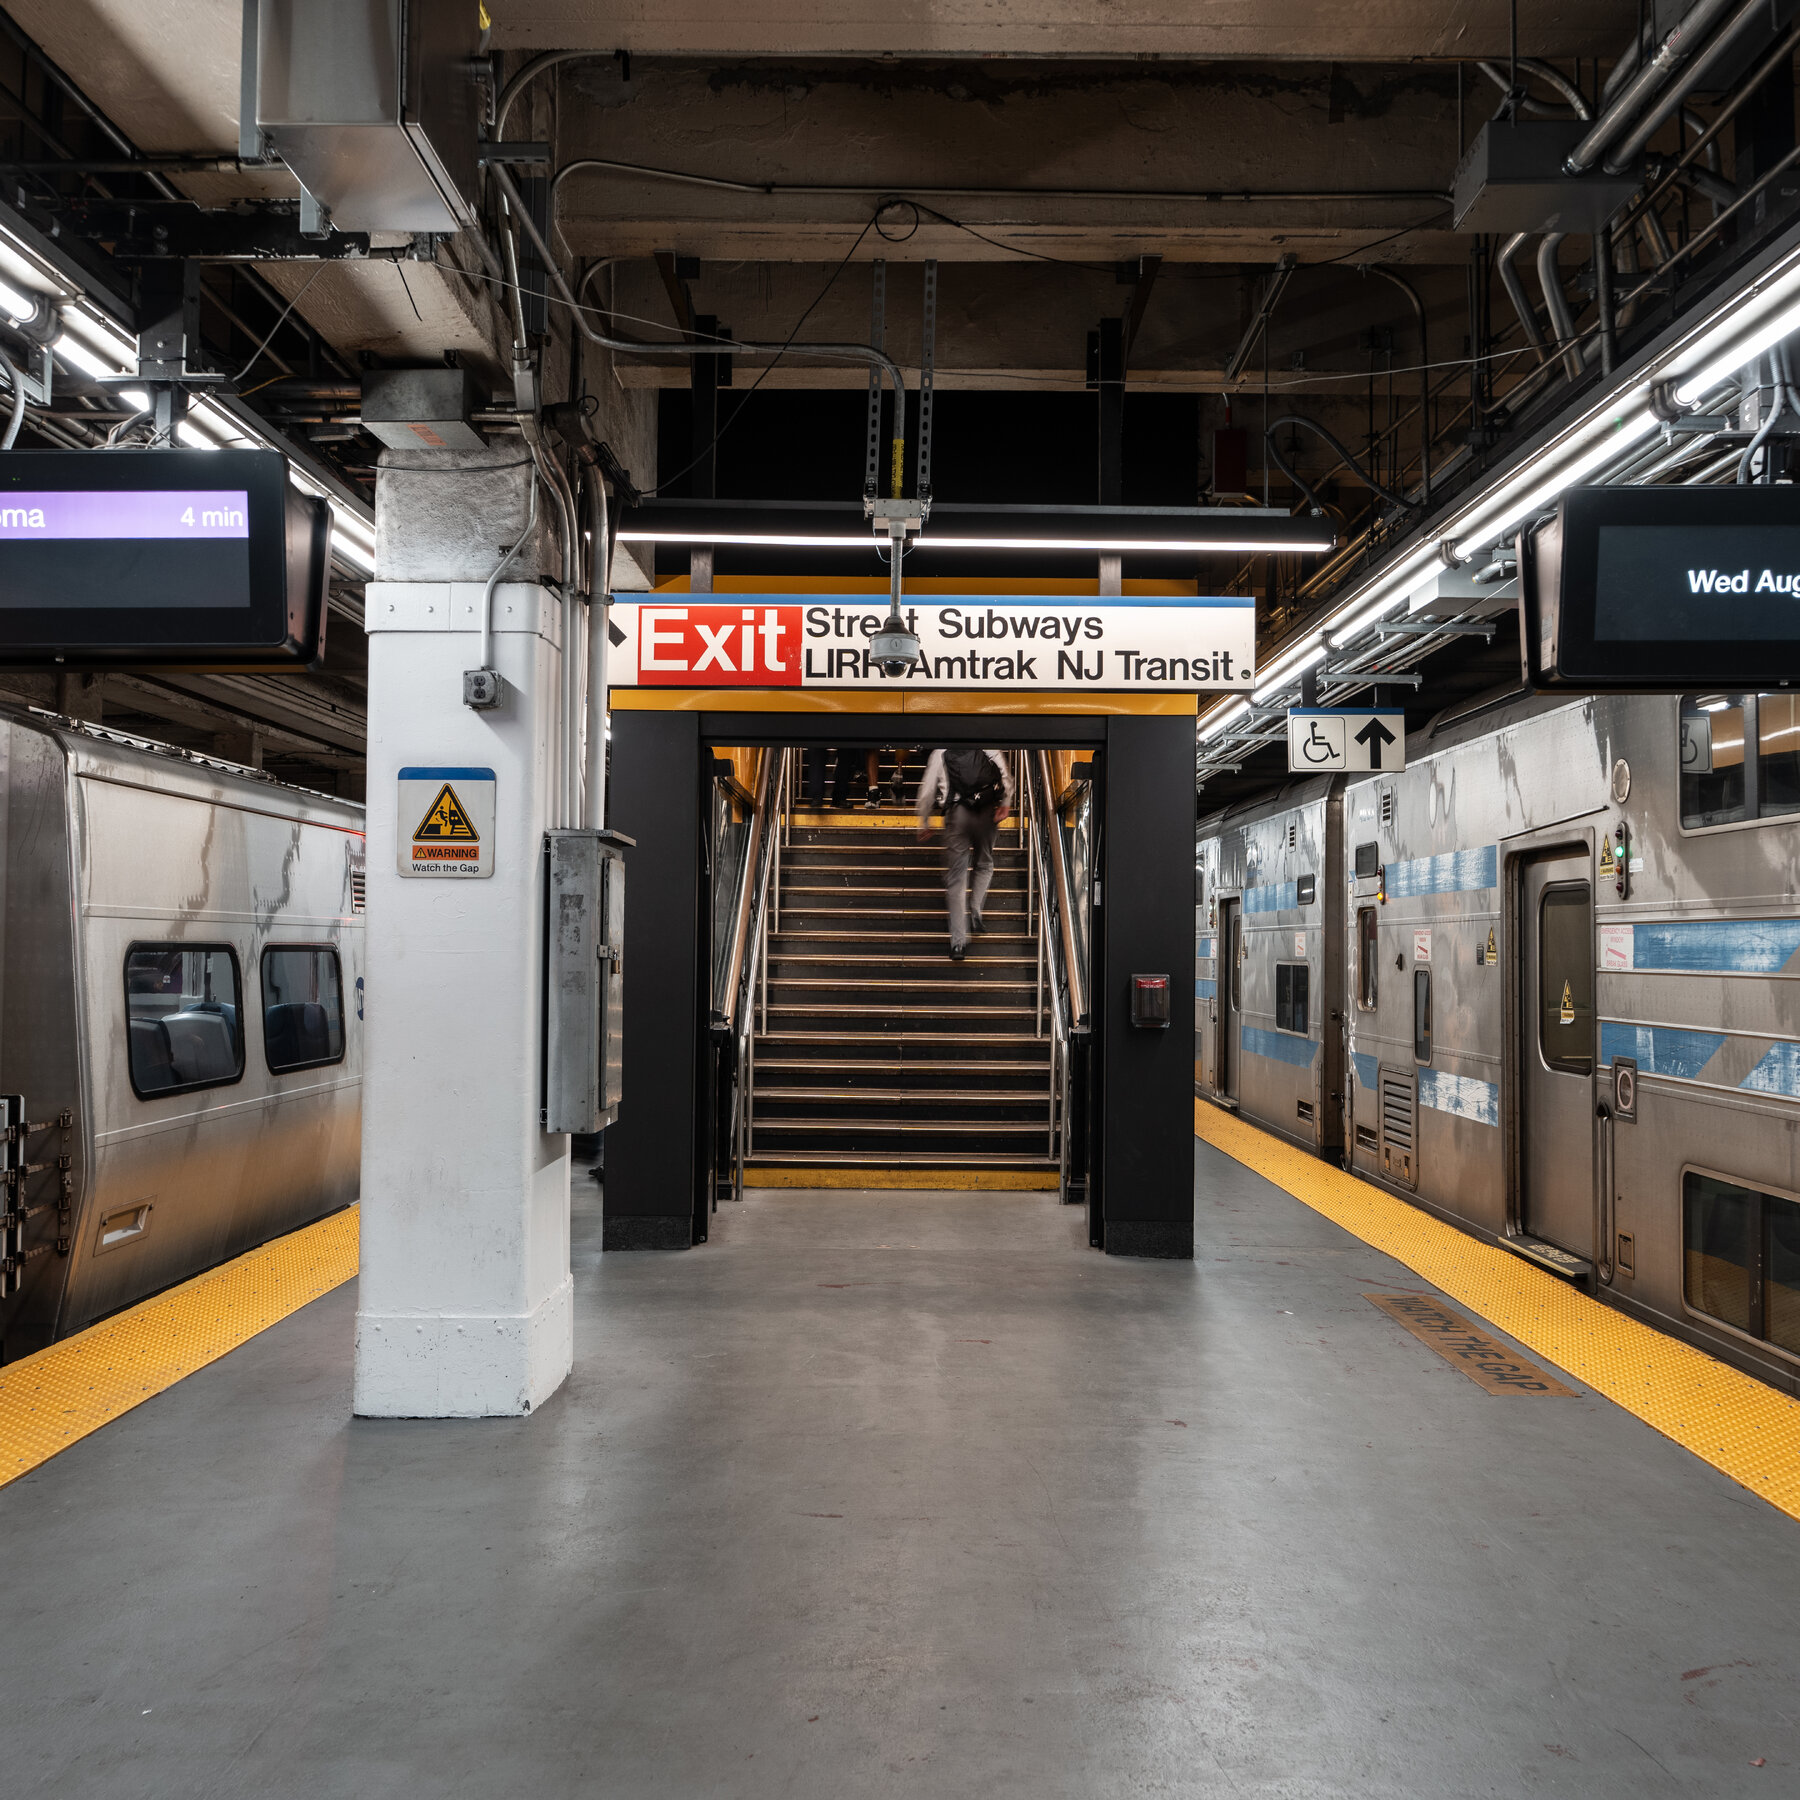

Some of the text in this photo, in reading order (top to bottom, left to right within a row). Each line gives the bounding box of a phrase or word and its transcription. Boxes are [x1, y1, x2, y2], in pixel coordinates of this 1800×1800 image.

[0, 506, 243, 528] ma 4 min
[1687, 569, 1800, 598] Wed Aug
[640, 608, 786, 672] Exit
[805, 607, 1104, 646] Stret Subways
[906, 649, 1038, 680] Amtrak
[1057, 650, 1104, 680] NJ
[1114, 650, 1234, 681] Transit
[427, 848, 477, 858] WARNING
[412, 863, 479, 874] Watch the Gap
[1385, 1297, 1549, 1391] WATCH THE GAP
